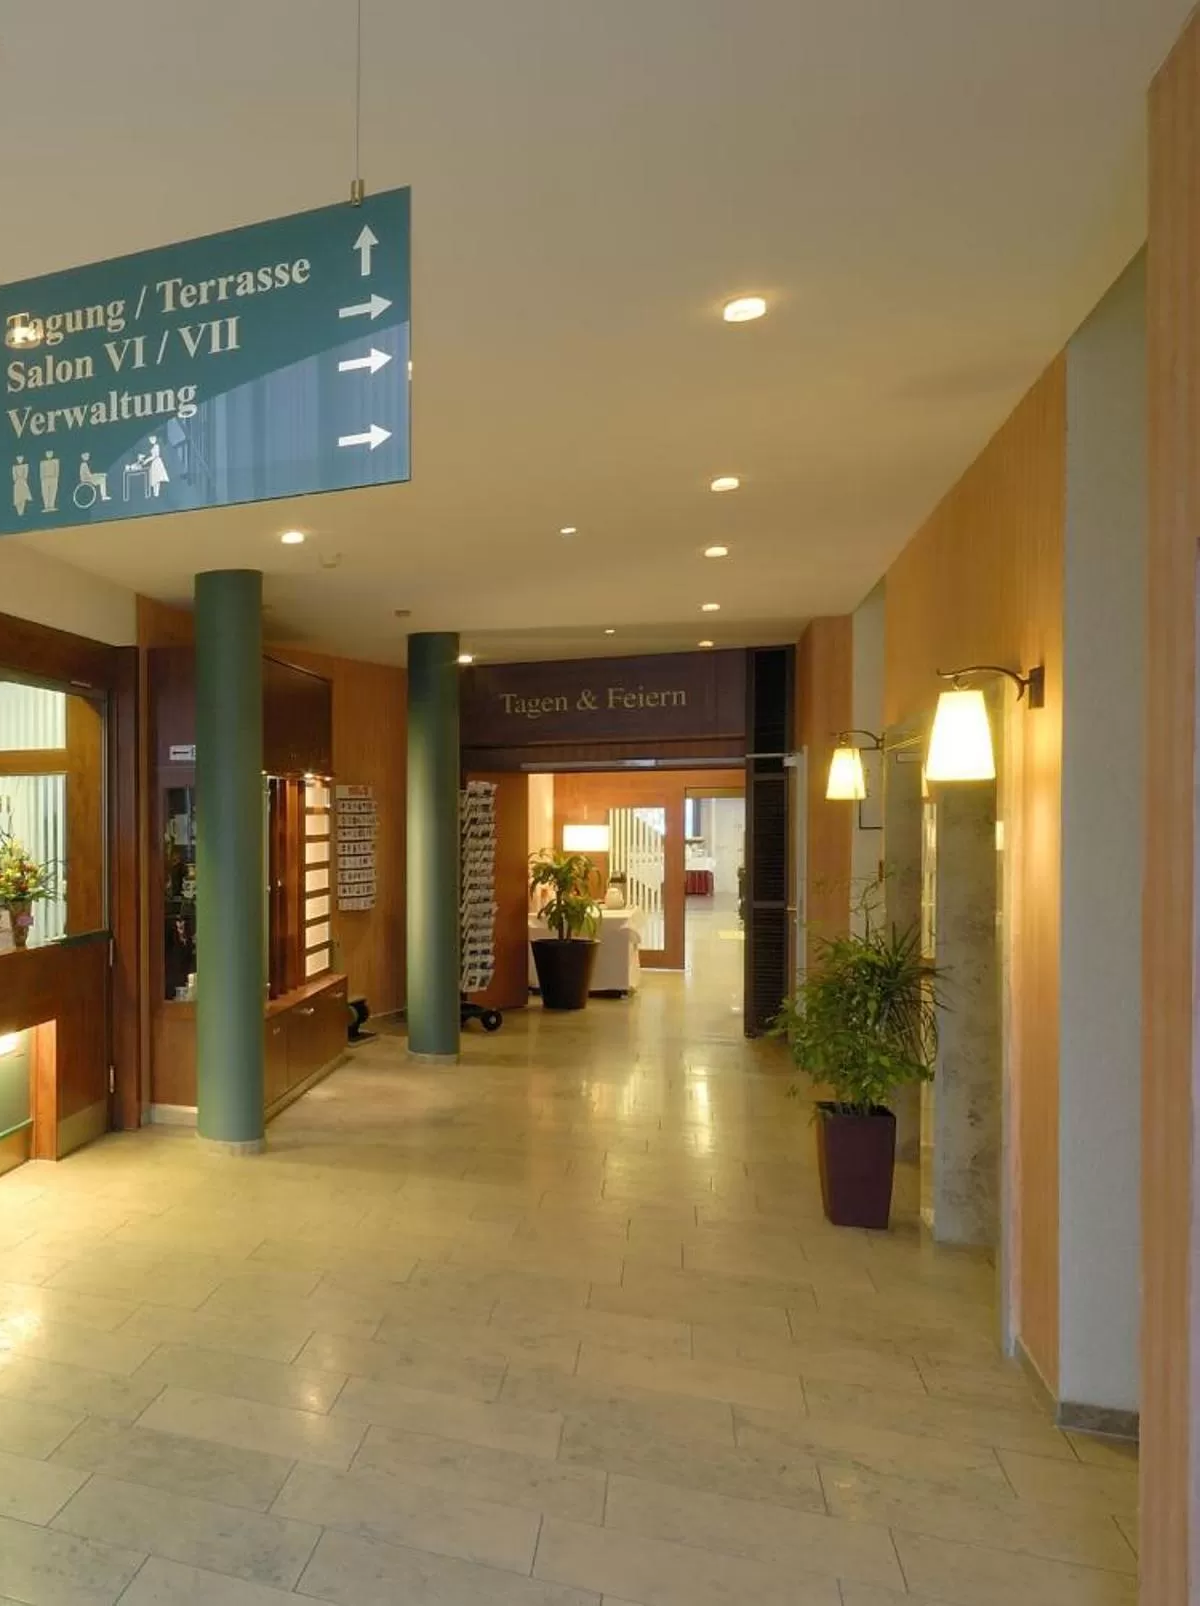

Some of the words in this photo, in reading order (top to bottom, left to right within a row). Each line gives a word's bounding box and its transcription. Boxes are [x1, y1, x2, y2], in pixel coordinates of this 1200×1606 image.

[5, 300, 126, 346] Tagung
[156, 257, 311, 313] Terrasse
[7, 353, 94, 393] Salon
[104, 336, 148, 372] VI
[178, 316, 241, 359] VII
[6, 384, 198, 439] Verwaltung
[500, 693, 568, 719] Tagen
[576, 689, 599, 711] &
[607, 684, 687, 710] Feiern
